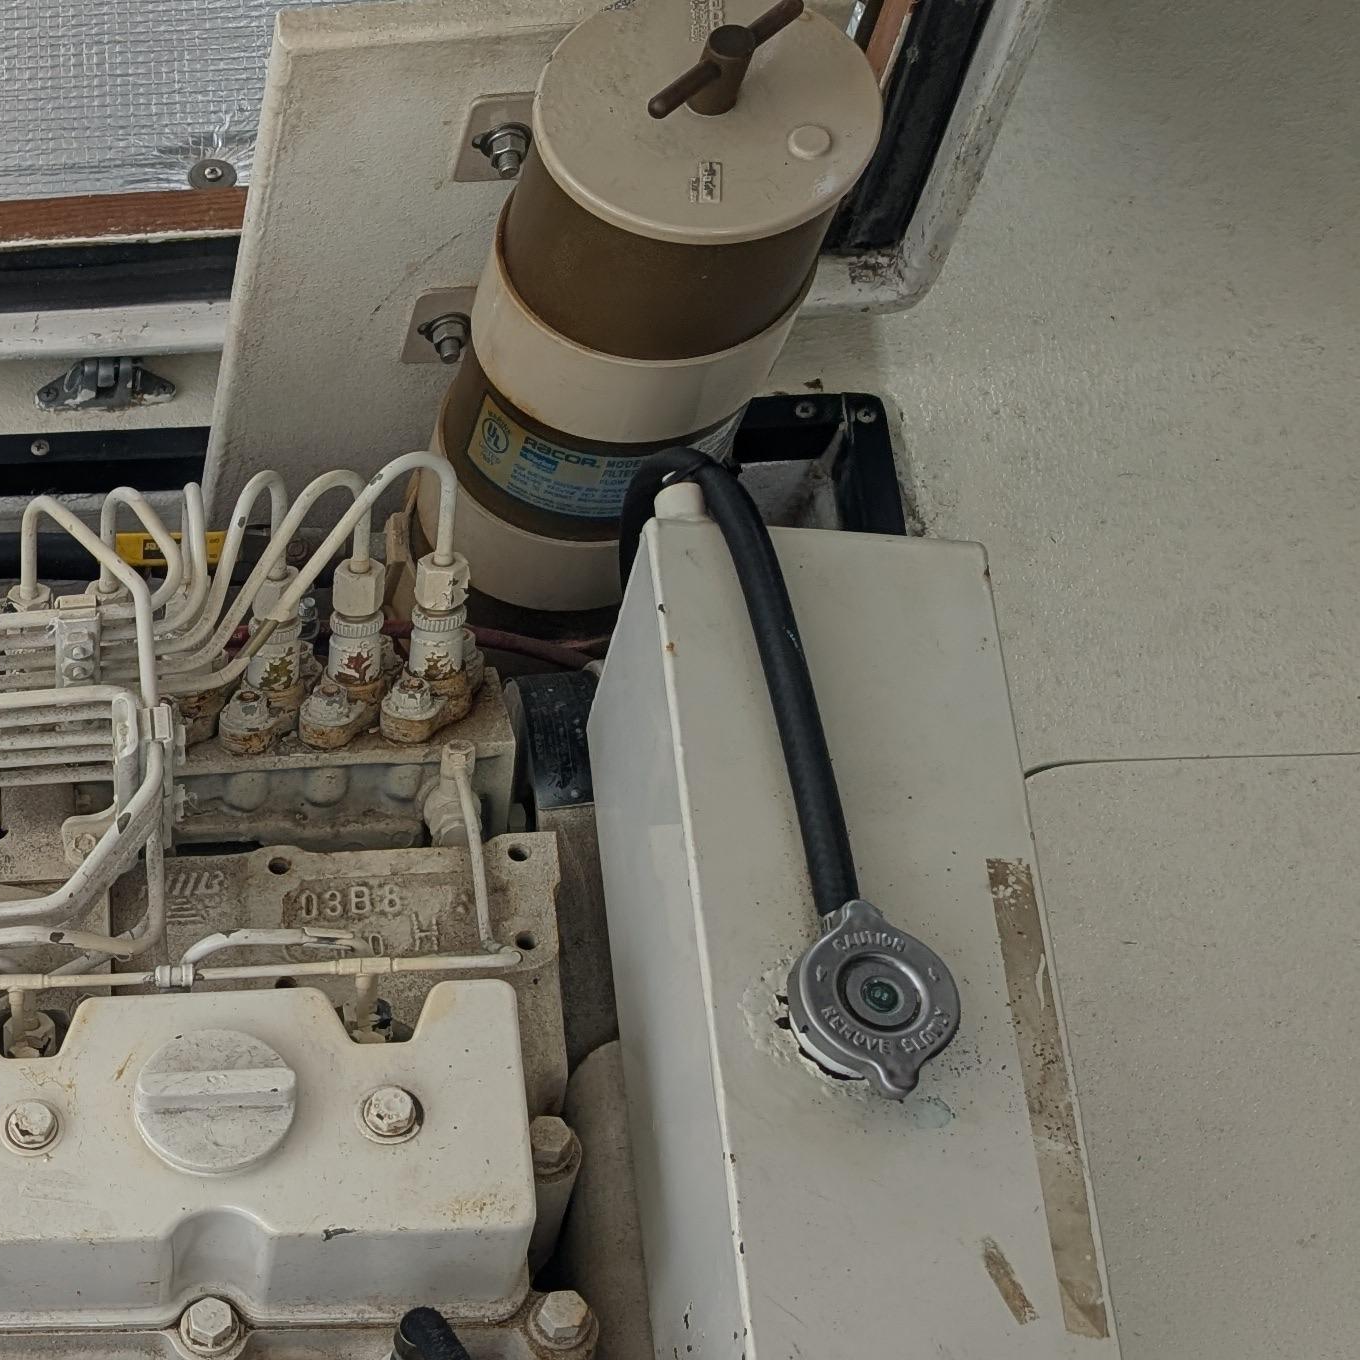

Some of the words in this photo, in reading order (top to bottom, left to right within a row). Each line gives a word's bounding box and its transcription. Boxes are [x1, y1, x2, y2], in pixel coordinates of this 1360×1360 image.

[606, 459, 642, 469] MODE
[831, 929, 907, 953] CAUTION
[820, 1004, 892, 1055] REMOVE
[899, 1006, 952, 1054] SLOWLY
